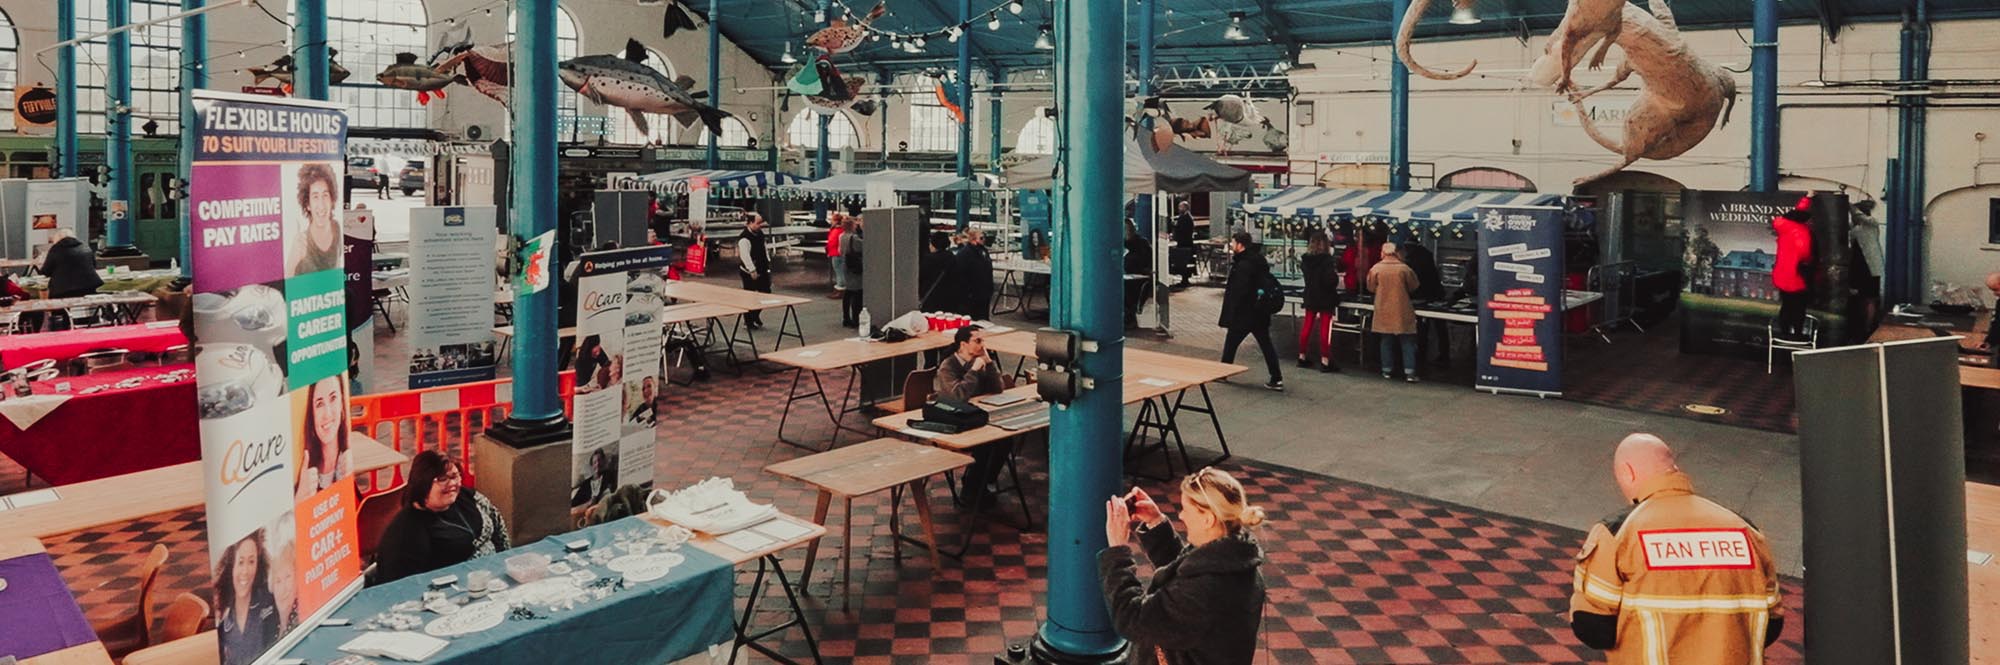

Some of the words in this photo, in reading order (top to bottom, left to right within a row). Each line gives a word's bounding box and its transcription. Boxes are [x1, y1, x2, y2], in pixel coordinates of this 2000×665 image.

[205, 106, 288, 133] FLEXIBLE
[290, 110, 341, 135] HOURS
[203, 136, 219, 153] TO
[222, 136, 255, 154] SUIT
[255, 137, 287, 154] YOUR
[198, 197, 281, 221] COMPETITIVE
[1710, 212, 1768, 223] WEDDING
[1719, 203, 1727, 212] A
[1730, 204, 1773, 214] BRAND
[203, 226, 236, 248] PAY
[240, 221, 280, 244] RATES
[584, 291, 623, 311] Qcare
[298, 313, 342, 339] CAREER
[290, 336, 347, 364] OPPORTUNITIES
[220, 433, 285, 486] Qcare
[313, 499, 328, 519] USE
[329, 494, 340, 508] OF
[310, 507, 345, 538] COMPANY
[311, 529, 344, 561] CAR+
[1650, 541, 1693, 559] TAN
[1699, 540, 1746, 558] FIRE
[305, 563, 325, 584] PAID
[325, 544, 351, 570] TRAVEL
[321, 569, 340, 591] TIME
